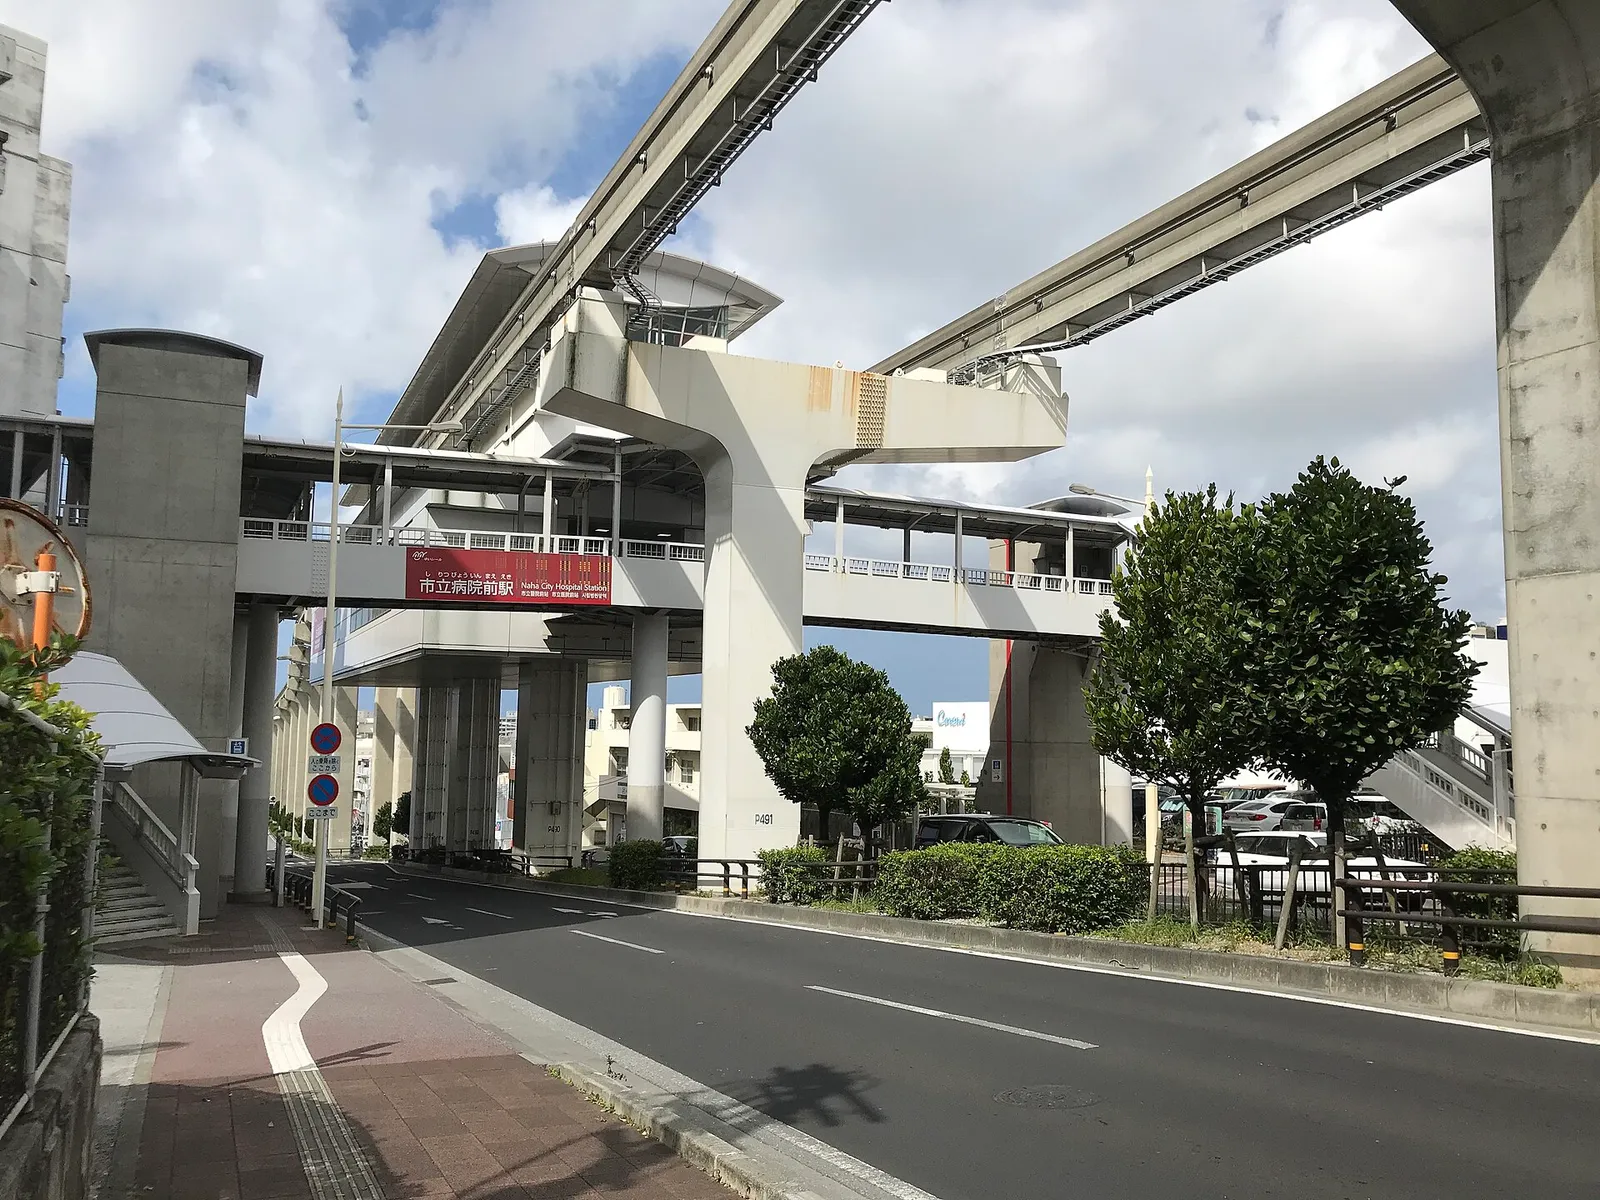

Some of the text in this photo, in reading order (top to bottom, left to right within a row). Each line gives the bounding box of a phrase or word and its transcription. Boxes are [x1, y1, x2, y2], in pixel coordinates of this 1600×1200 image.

[419, 578, 514, 596] 市立病院前駅
[521, 581, 607, 592] Naha City Hospital Station
[312, 764, 337, 772] ここから
[308, 809, 336, 817] ここまで
[755, 813, 773, 825] P491
